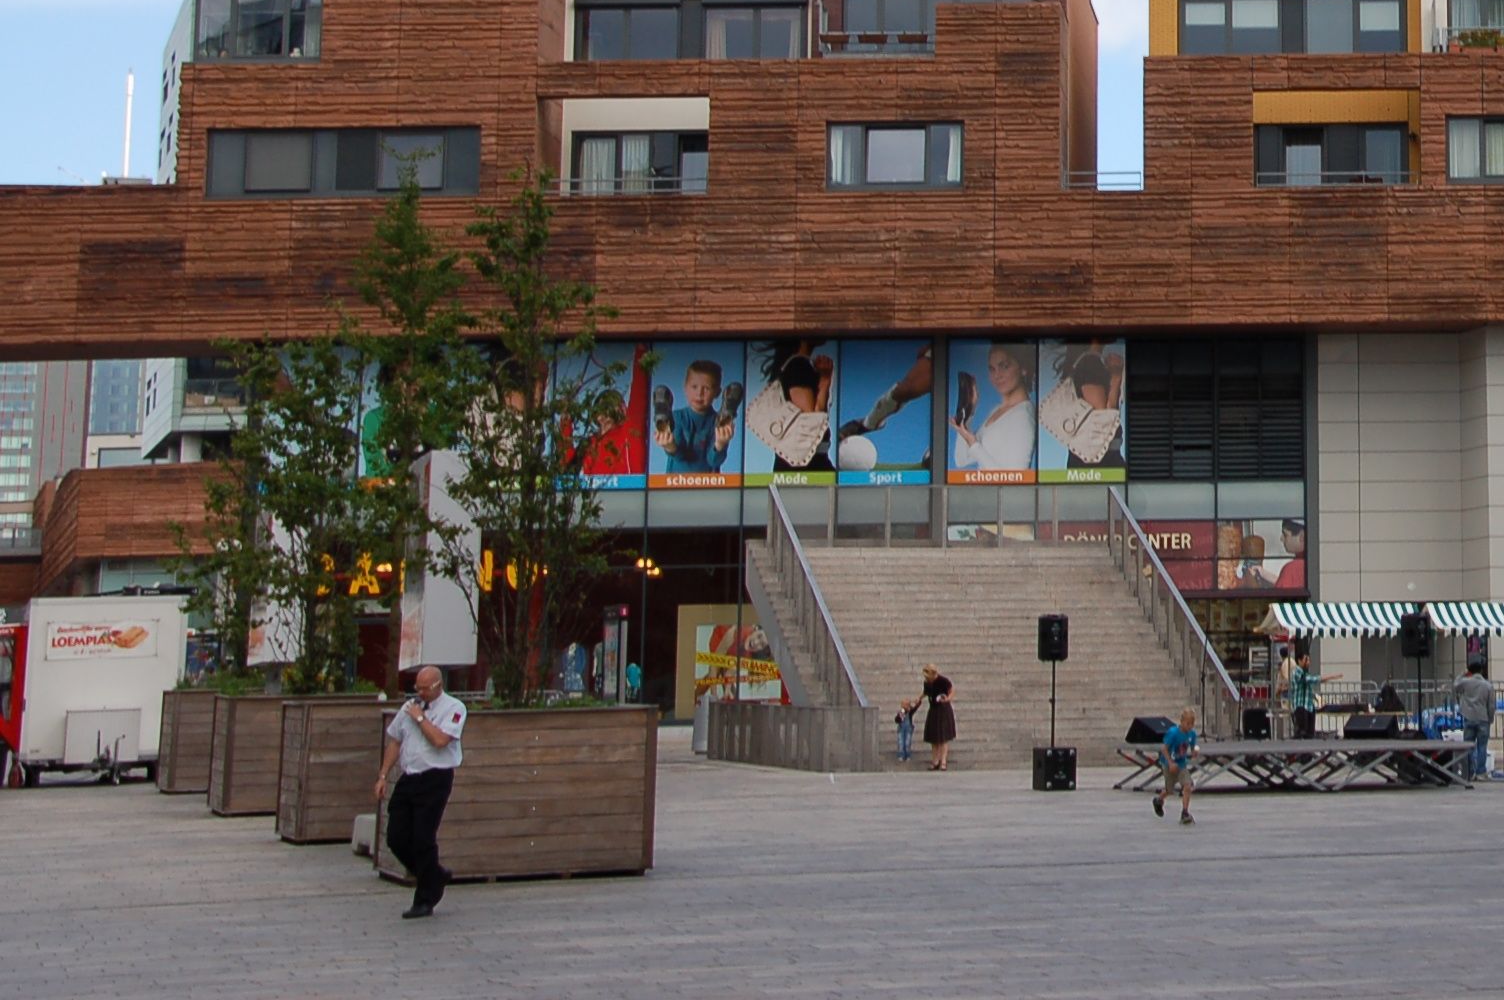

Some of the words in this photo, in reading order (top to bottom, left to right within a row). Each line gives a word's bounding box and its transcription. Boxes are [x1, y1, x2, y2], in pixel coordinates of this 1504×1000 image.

[666, 474, 726, 486] schoenen
[773, 473, 808, 485] Mode
[869, 472, 903, 485] Sport
[965, 471, 1023, 482] schoenen
[1066, 469, 1101, 482] Mode
[1127, 533, 1192, 550] CNTER
